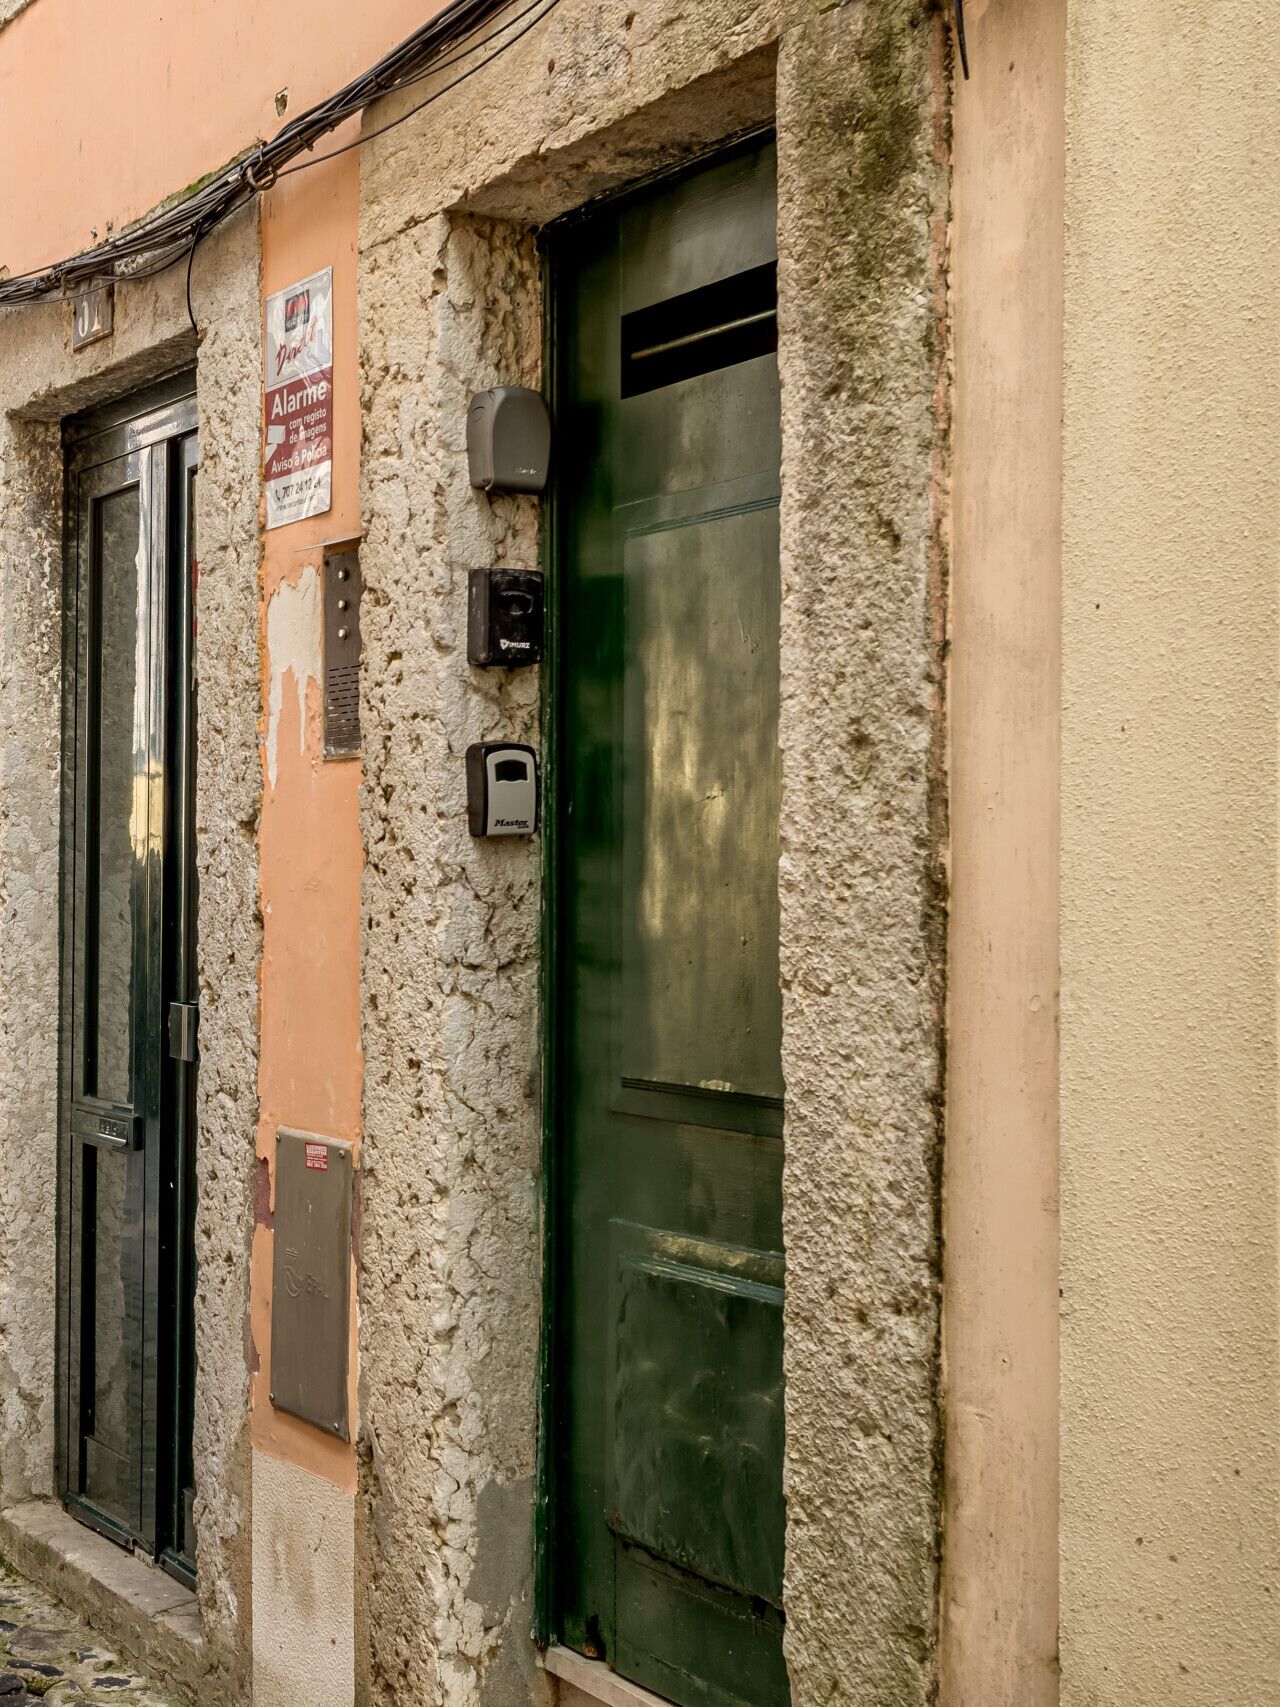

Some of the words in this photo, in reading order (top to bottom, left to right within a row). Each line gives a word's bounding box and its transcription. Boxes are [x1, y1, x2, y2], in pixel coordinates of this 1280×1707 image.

[271, 381, 328, 420] Alarme
[289, 418, 302, 430] com
[304, 407, 327, 425] registo
[289, 431, 298, 444] de
[271, 459, 293, 475] Aviso
[294, 452, 300, 467] à
[301, 444, 327, 464] Polícia
[282, 484, 294, 500] 707
[295, 481, 303, 495] 24
[494, 819, 528, 827] Master
